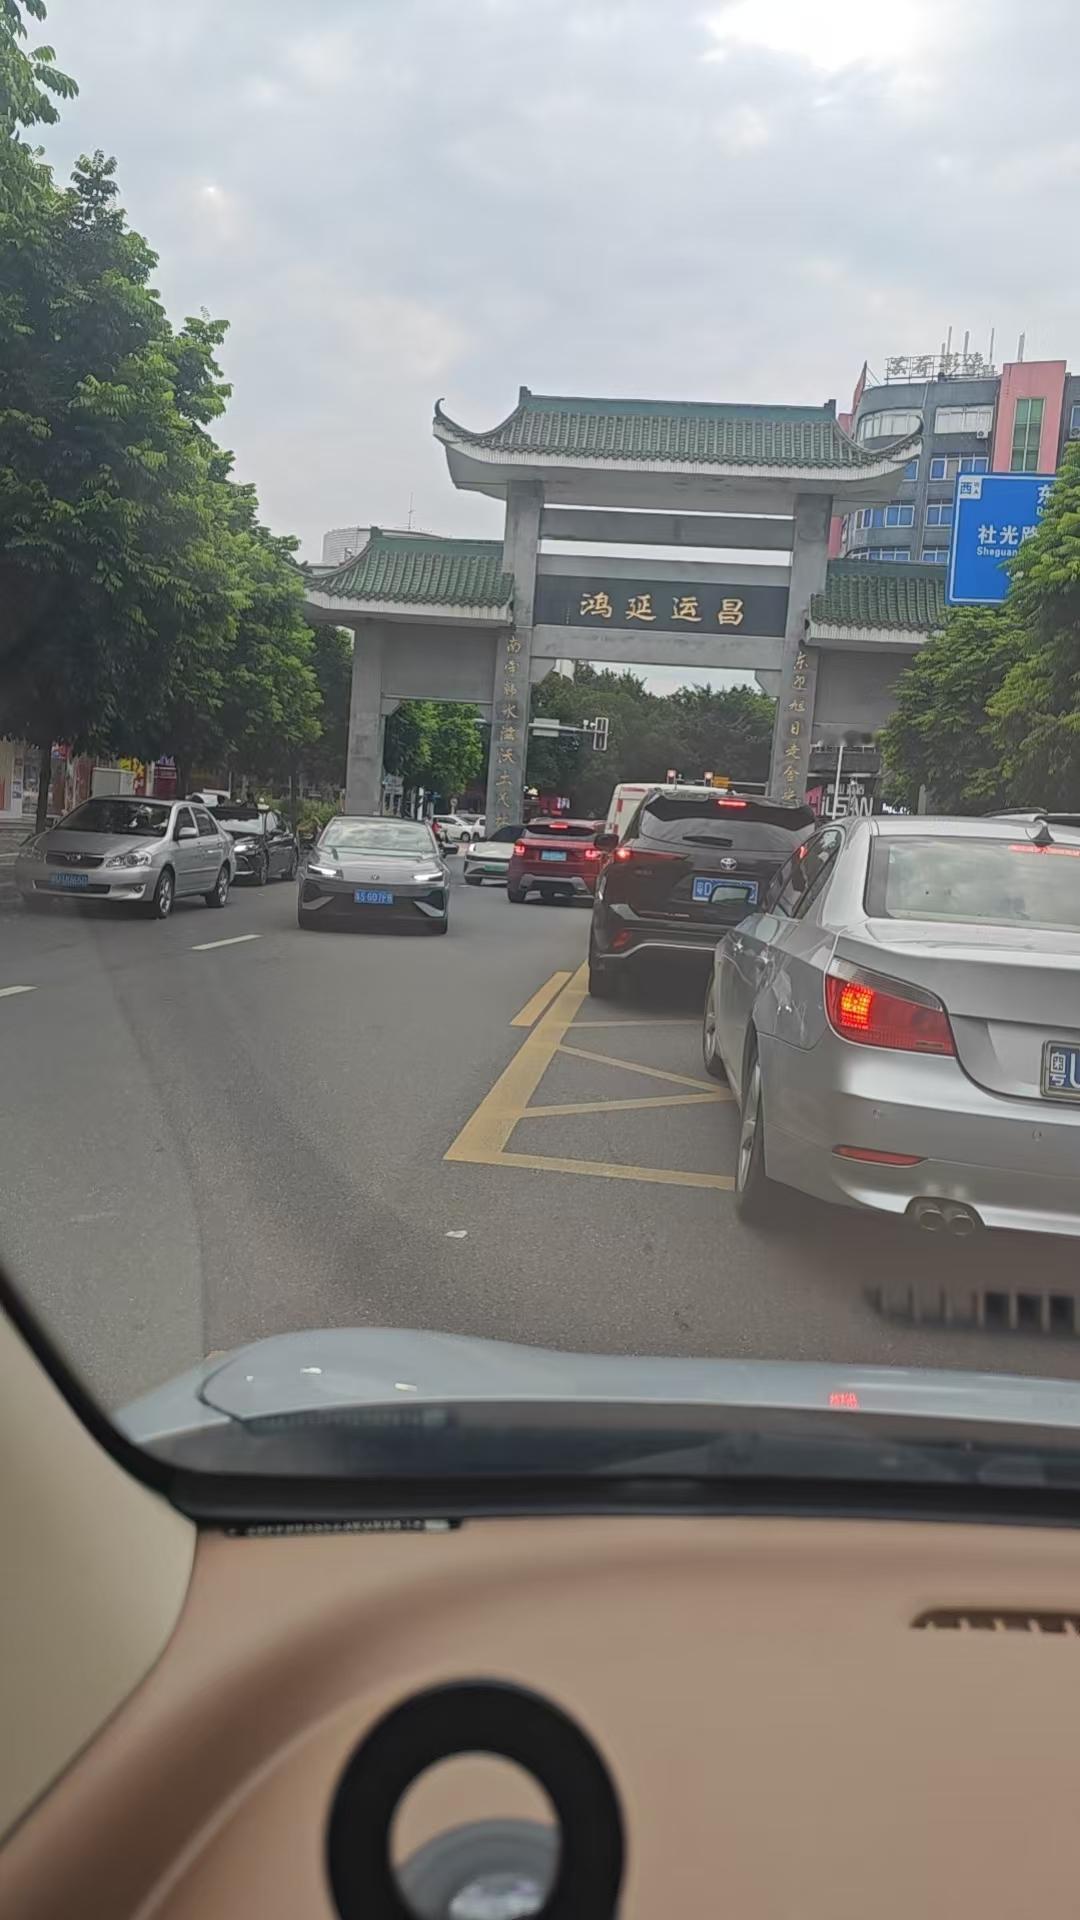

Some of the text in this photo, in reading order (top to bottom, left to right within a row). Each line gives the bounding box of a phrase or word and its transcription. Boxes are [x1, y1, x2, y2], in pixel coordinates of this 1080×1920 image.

[978, 525, 1040, 545] 社光路
[976, 546, 1019, 557] Sheguan
